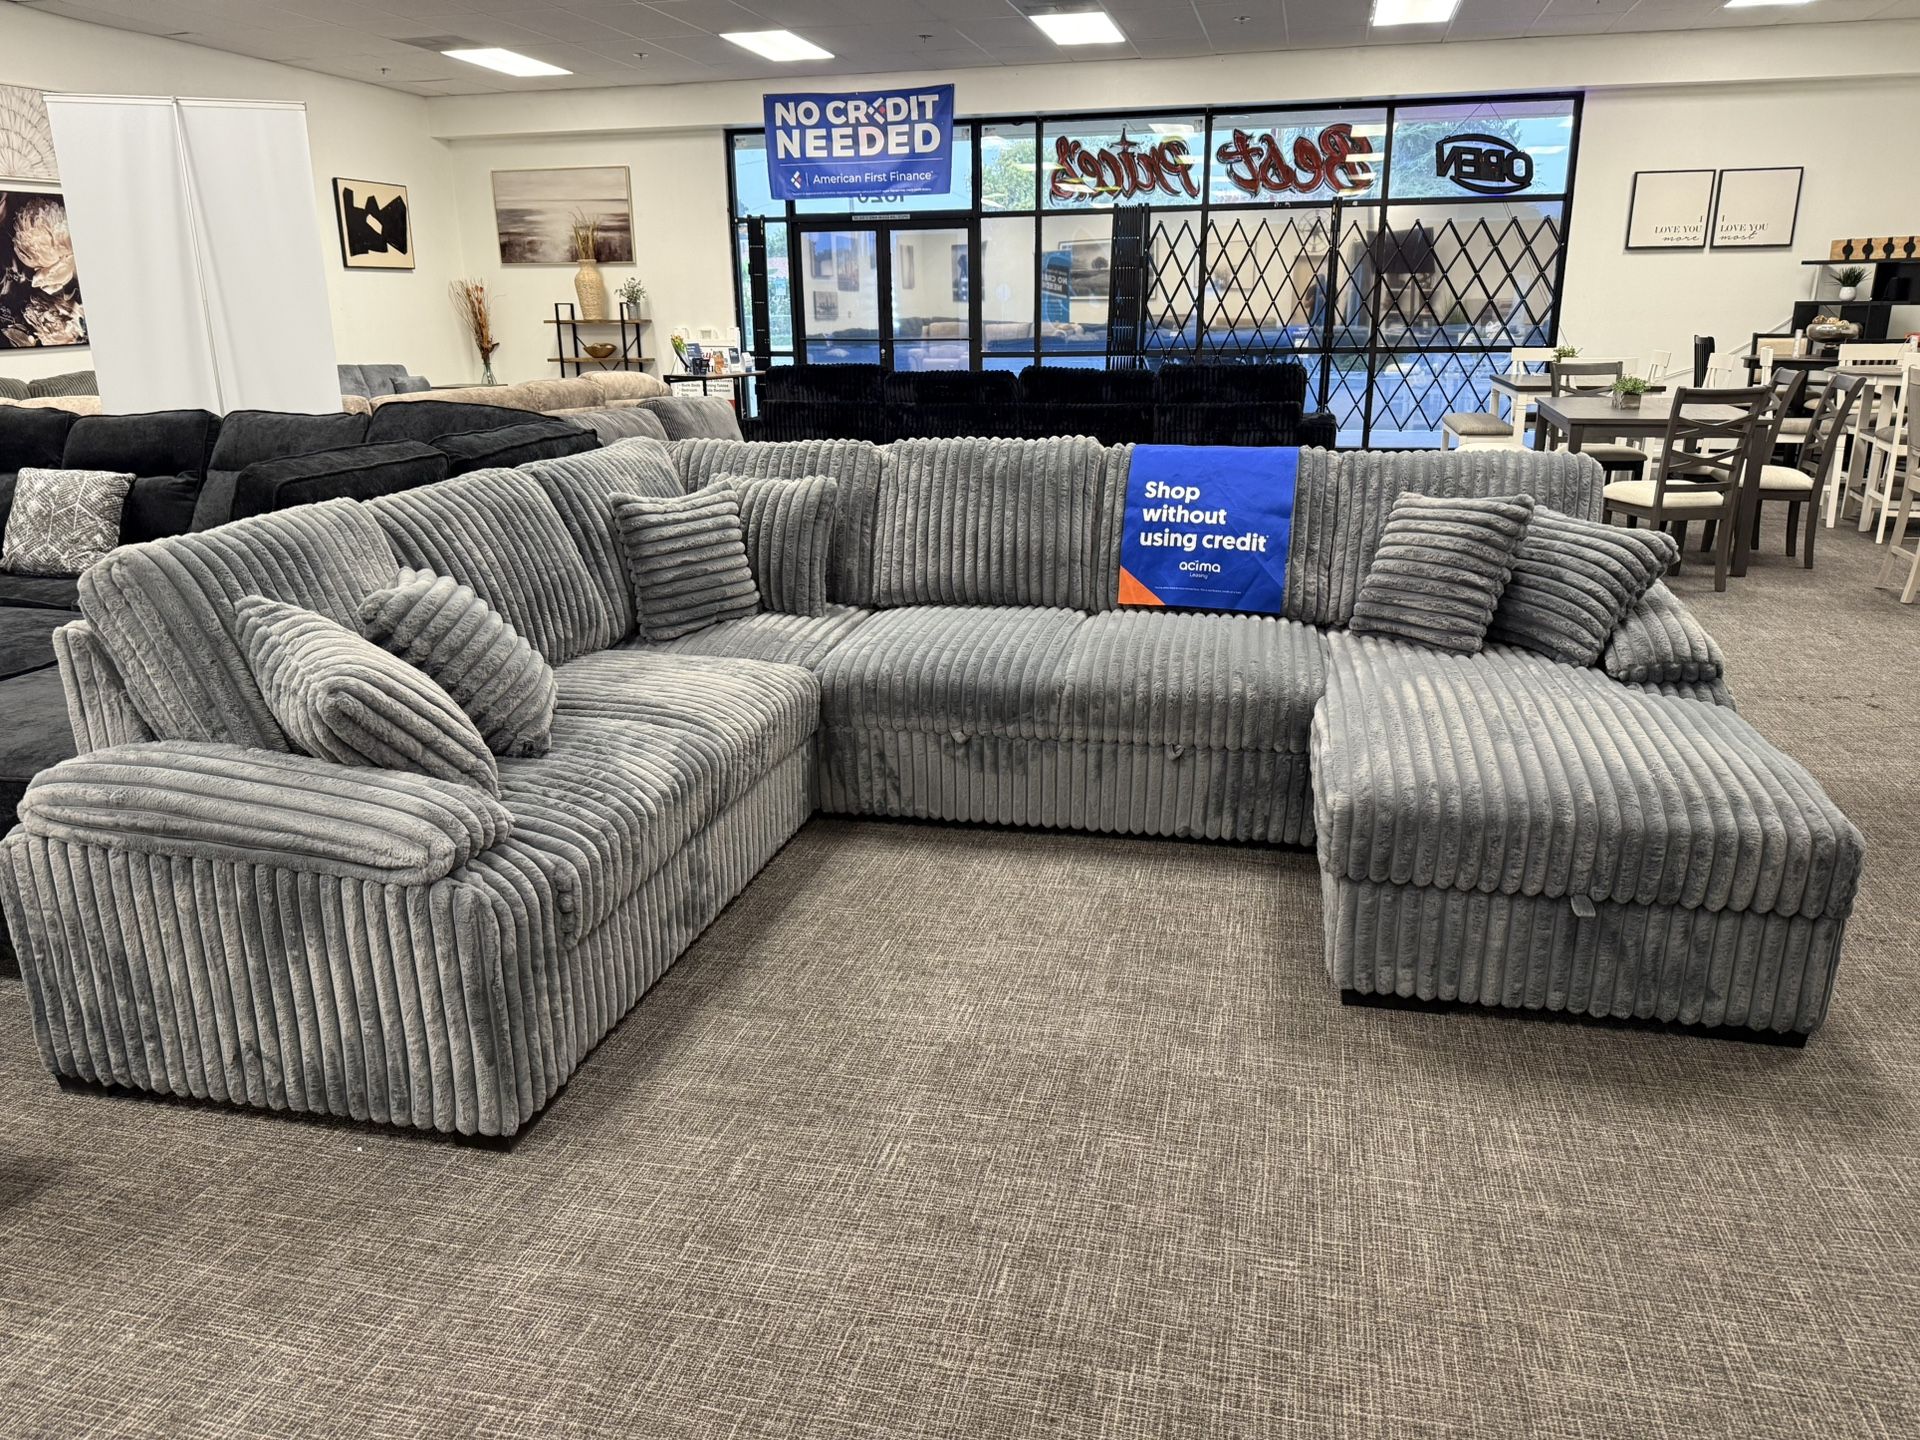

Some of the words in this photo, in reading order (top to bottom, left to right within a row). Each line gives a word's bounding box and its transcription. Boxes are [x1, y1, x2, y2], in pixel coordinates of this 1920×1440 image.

[775, 101, 820, 127] NO
[777, 123, 941, 159] NEEDED
[813, 173, 862, 184] American
[864, 172, 887, 182] First
[890, 170, 933, 180] Finance
[1654, 225, 1681, 234] LOVE
[1683, 225, 1703, 233] YOU
[1719, 230, 1757, 241] most
[1720, 224, 1747, 232] LOVE
[1749, 223, 1769, 231] YOU
[1144, 481, 1200, 503] Shop
[1142, 504, 1227, 525] without
[1139, 528, 1197, 551] using
[1179, 560, 1221, 573] acima
